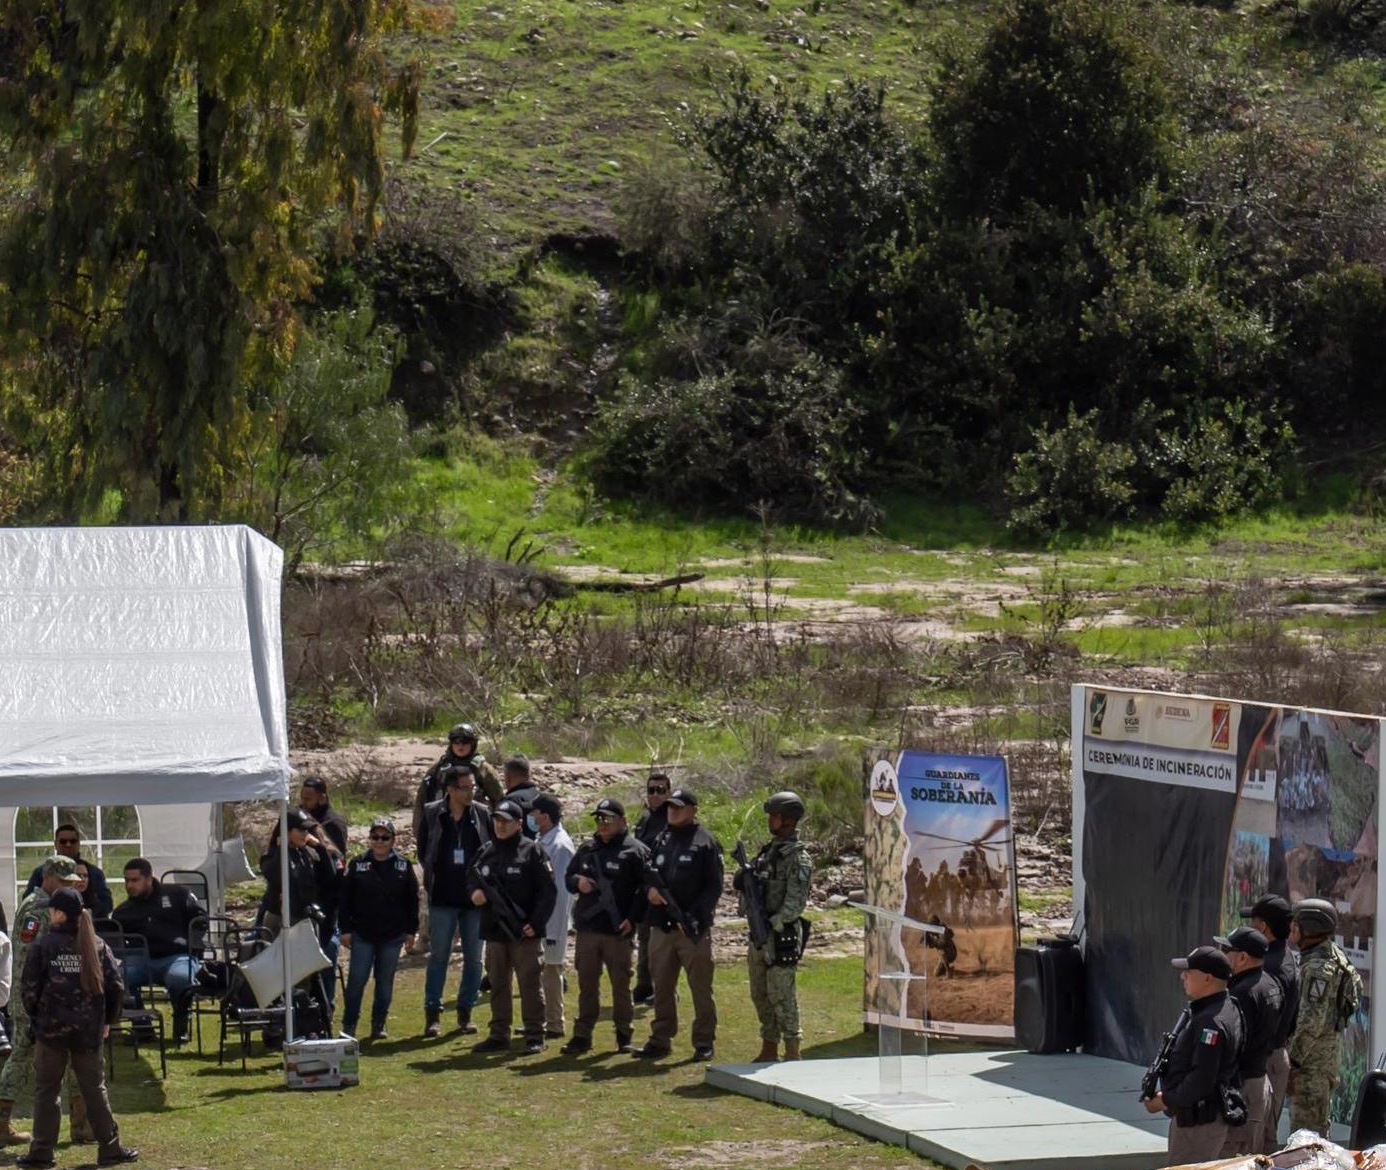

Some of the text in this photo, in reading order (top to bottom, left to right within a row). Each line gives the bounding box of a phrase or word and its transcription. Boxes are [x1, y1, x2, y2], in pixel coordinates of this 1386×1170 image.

[1088, 750, 1232, 781] CEREMONIA DE INCINERACIÓN
[925, 769, 981, 781] GUARDIANES
[940, 781, 964, 791] DE LA
[910, 786, 998, 806] SOBERANÍA
